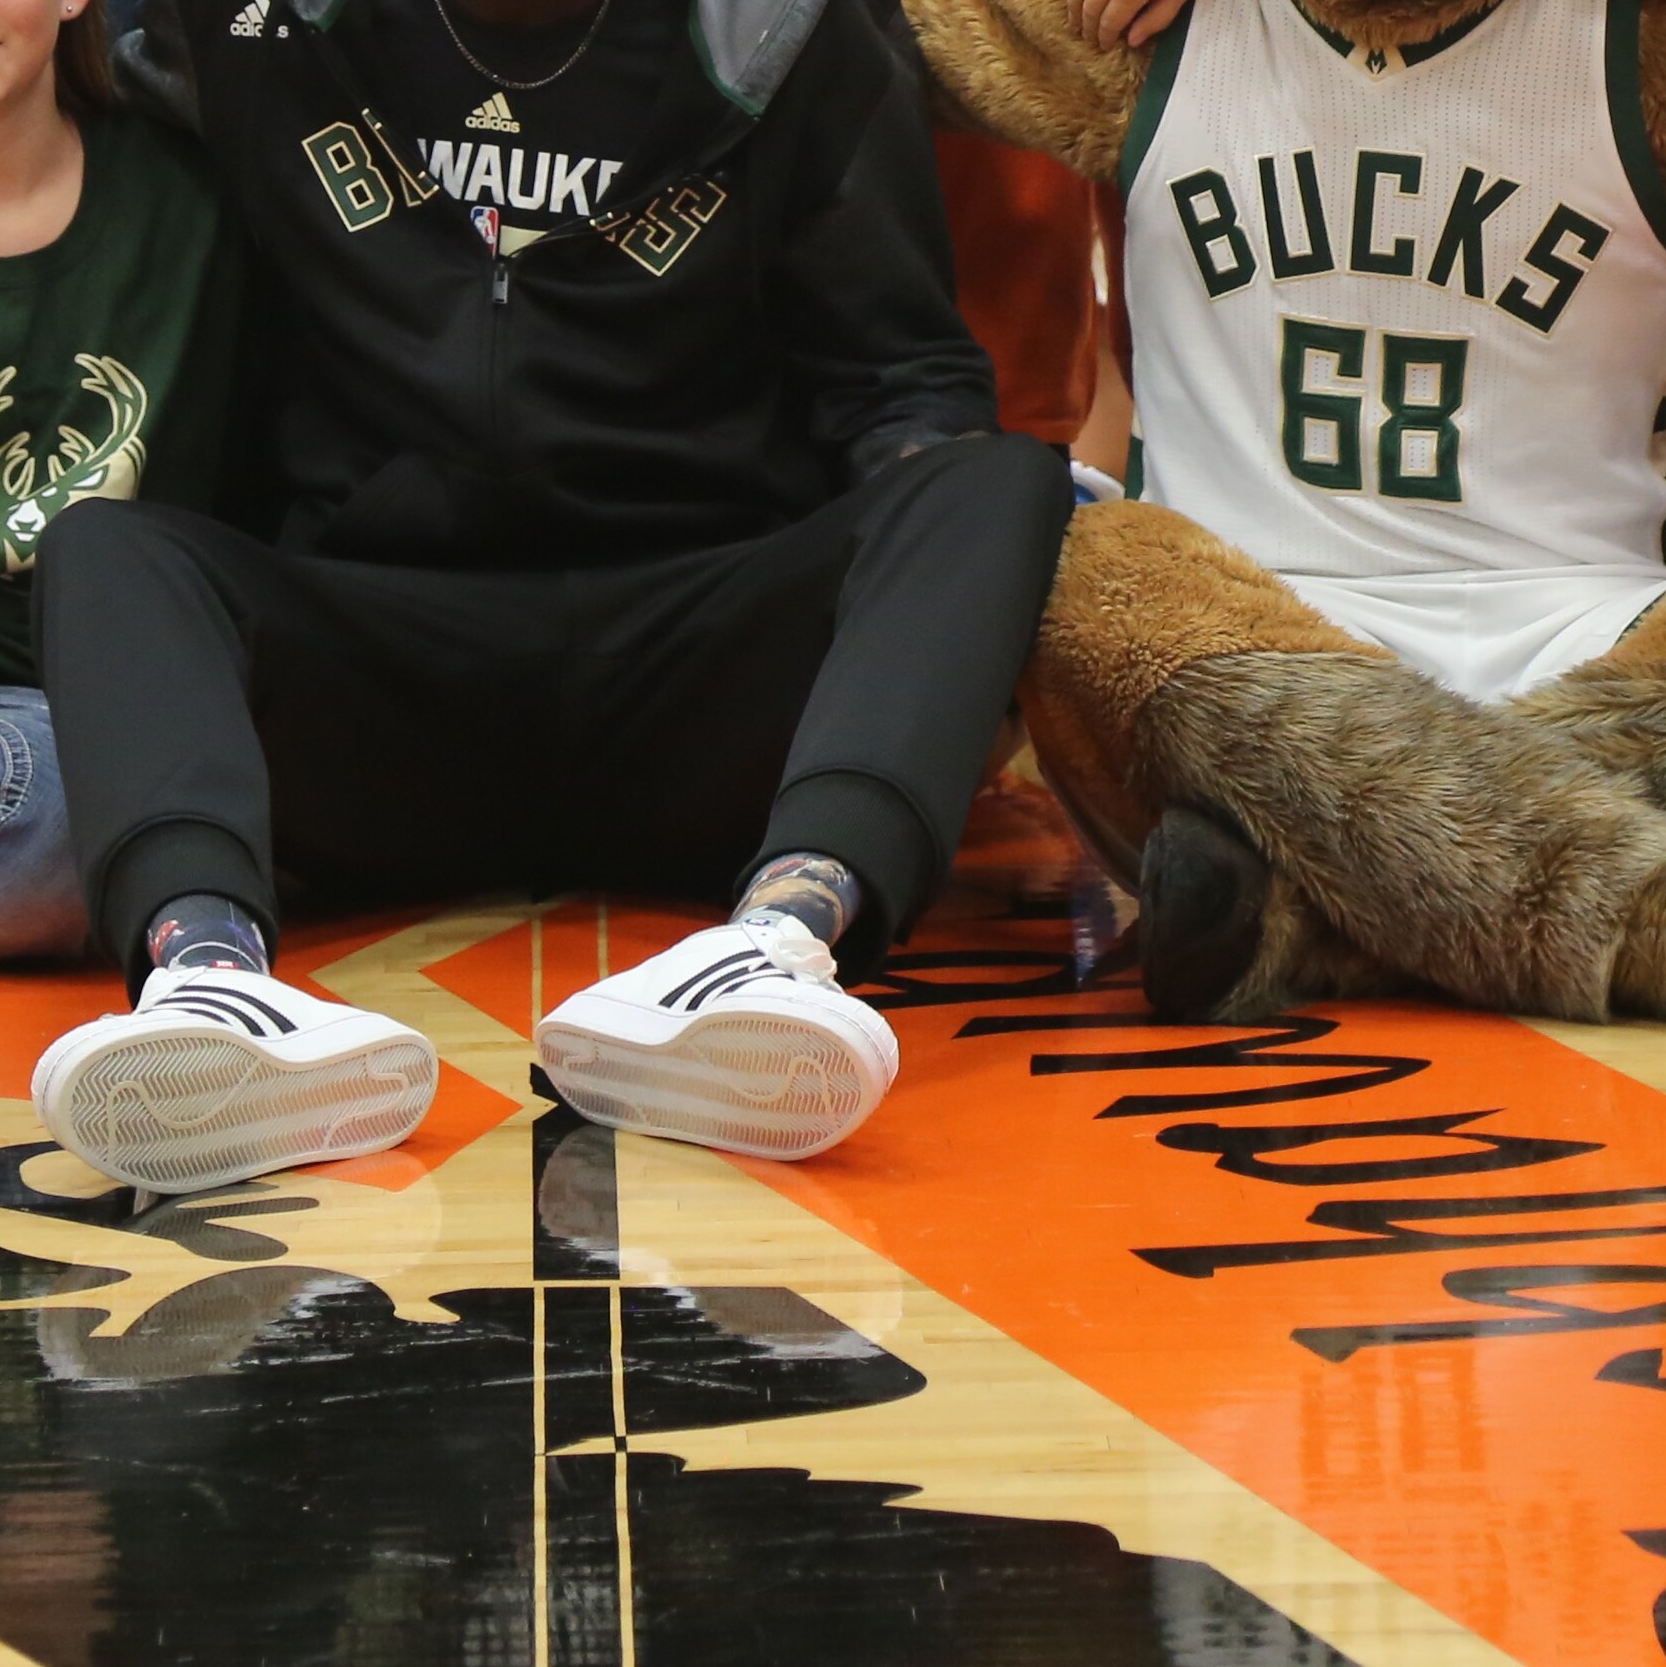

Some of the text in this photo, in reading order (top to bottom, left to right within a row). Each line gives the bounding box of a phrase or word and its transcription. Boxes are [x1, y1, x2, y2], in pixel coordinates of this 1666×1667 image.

[230, 21, 290, 38] adis
[465, 114, 520, 134] adidas
[1165, 146, 1615, 339] BUCKS
[1277, 312, 1472, 504] 68
